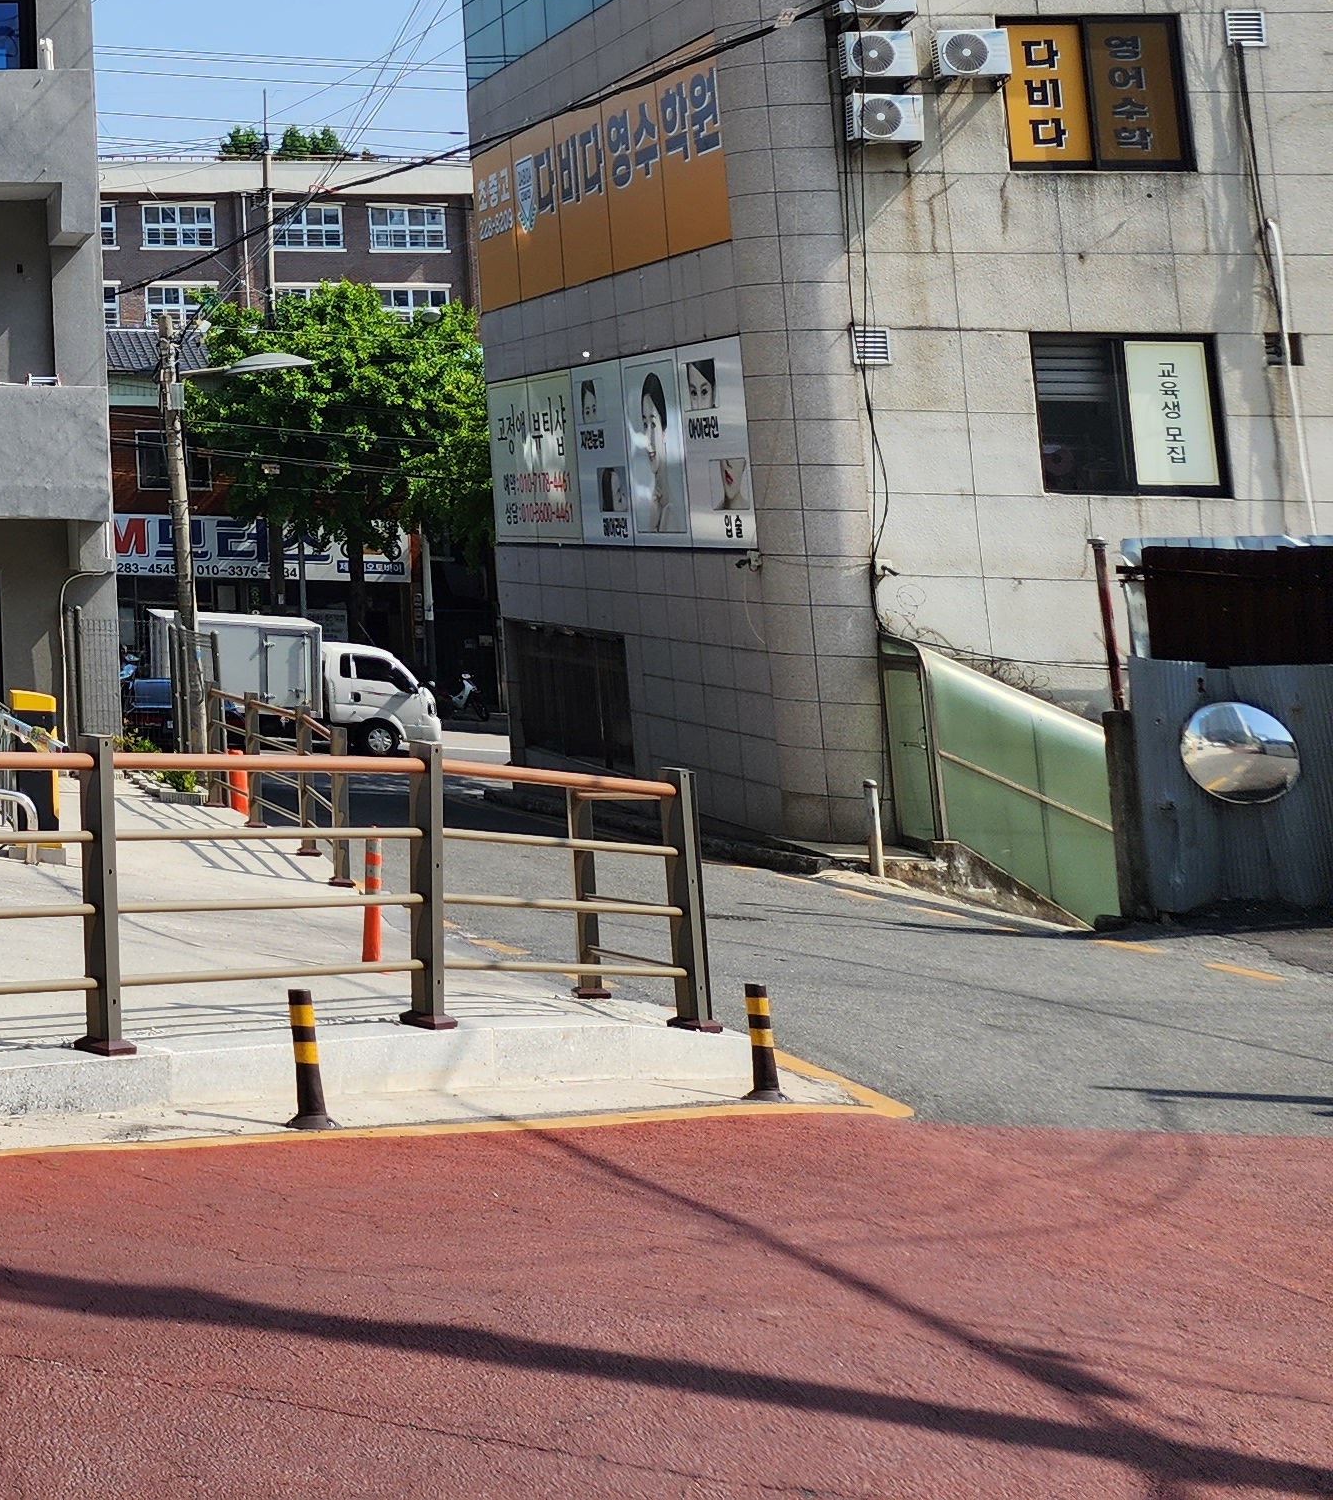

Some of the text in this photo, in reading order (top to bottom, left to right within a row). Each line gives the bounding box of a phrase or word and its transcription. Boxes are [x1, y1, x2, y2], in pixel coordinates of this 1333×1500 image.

[533, 66, 722, 215] 다비다영수학원
[1021, 39, 1068, 149] 다비다
[1103, 35, 1154, 152] 영어수학
[532, 394, 567, 457] 뷰티샵
[688, 415, 720, 440] 아이라인
[1157, 362, 1186, 464] 교육생 모집
